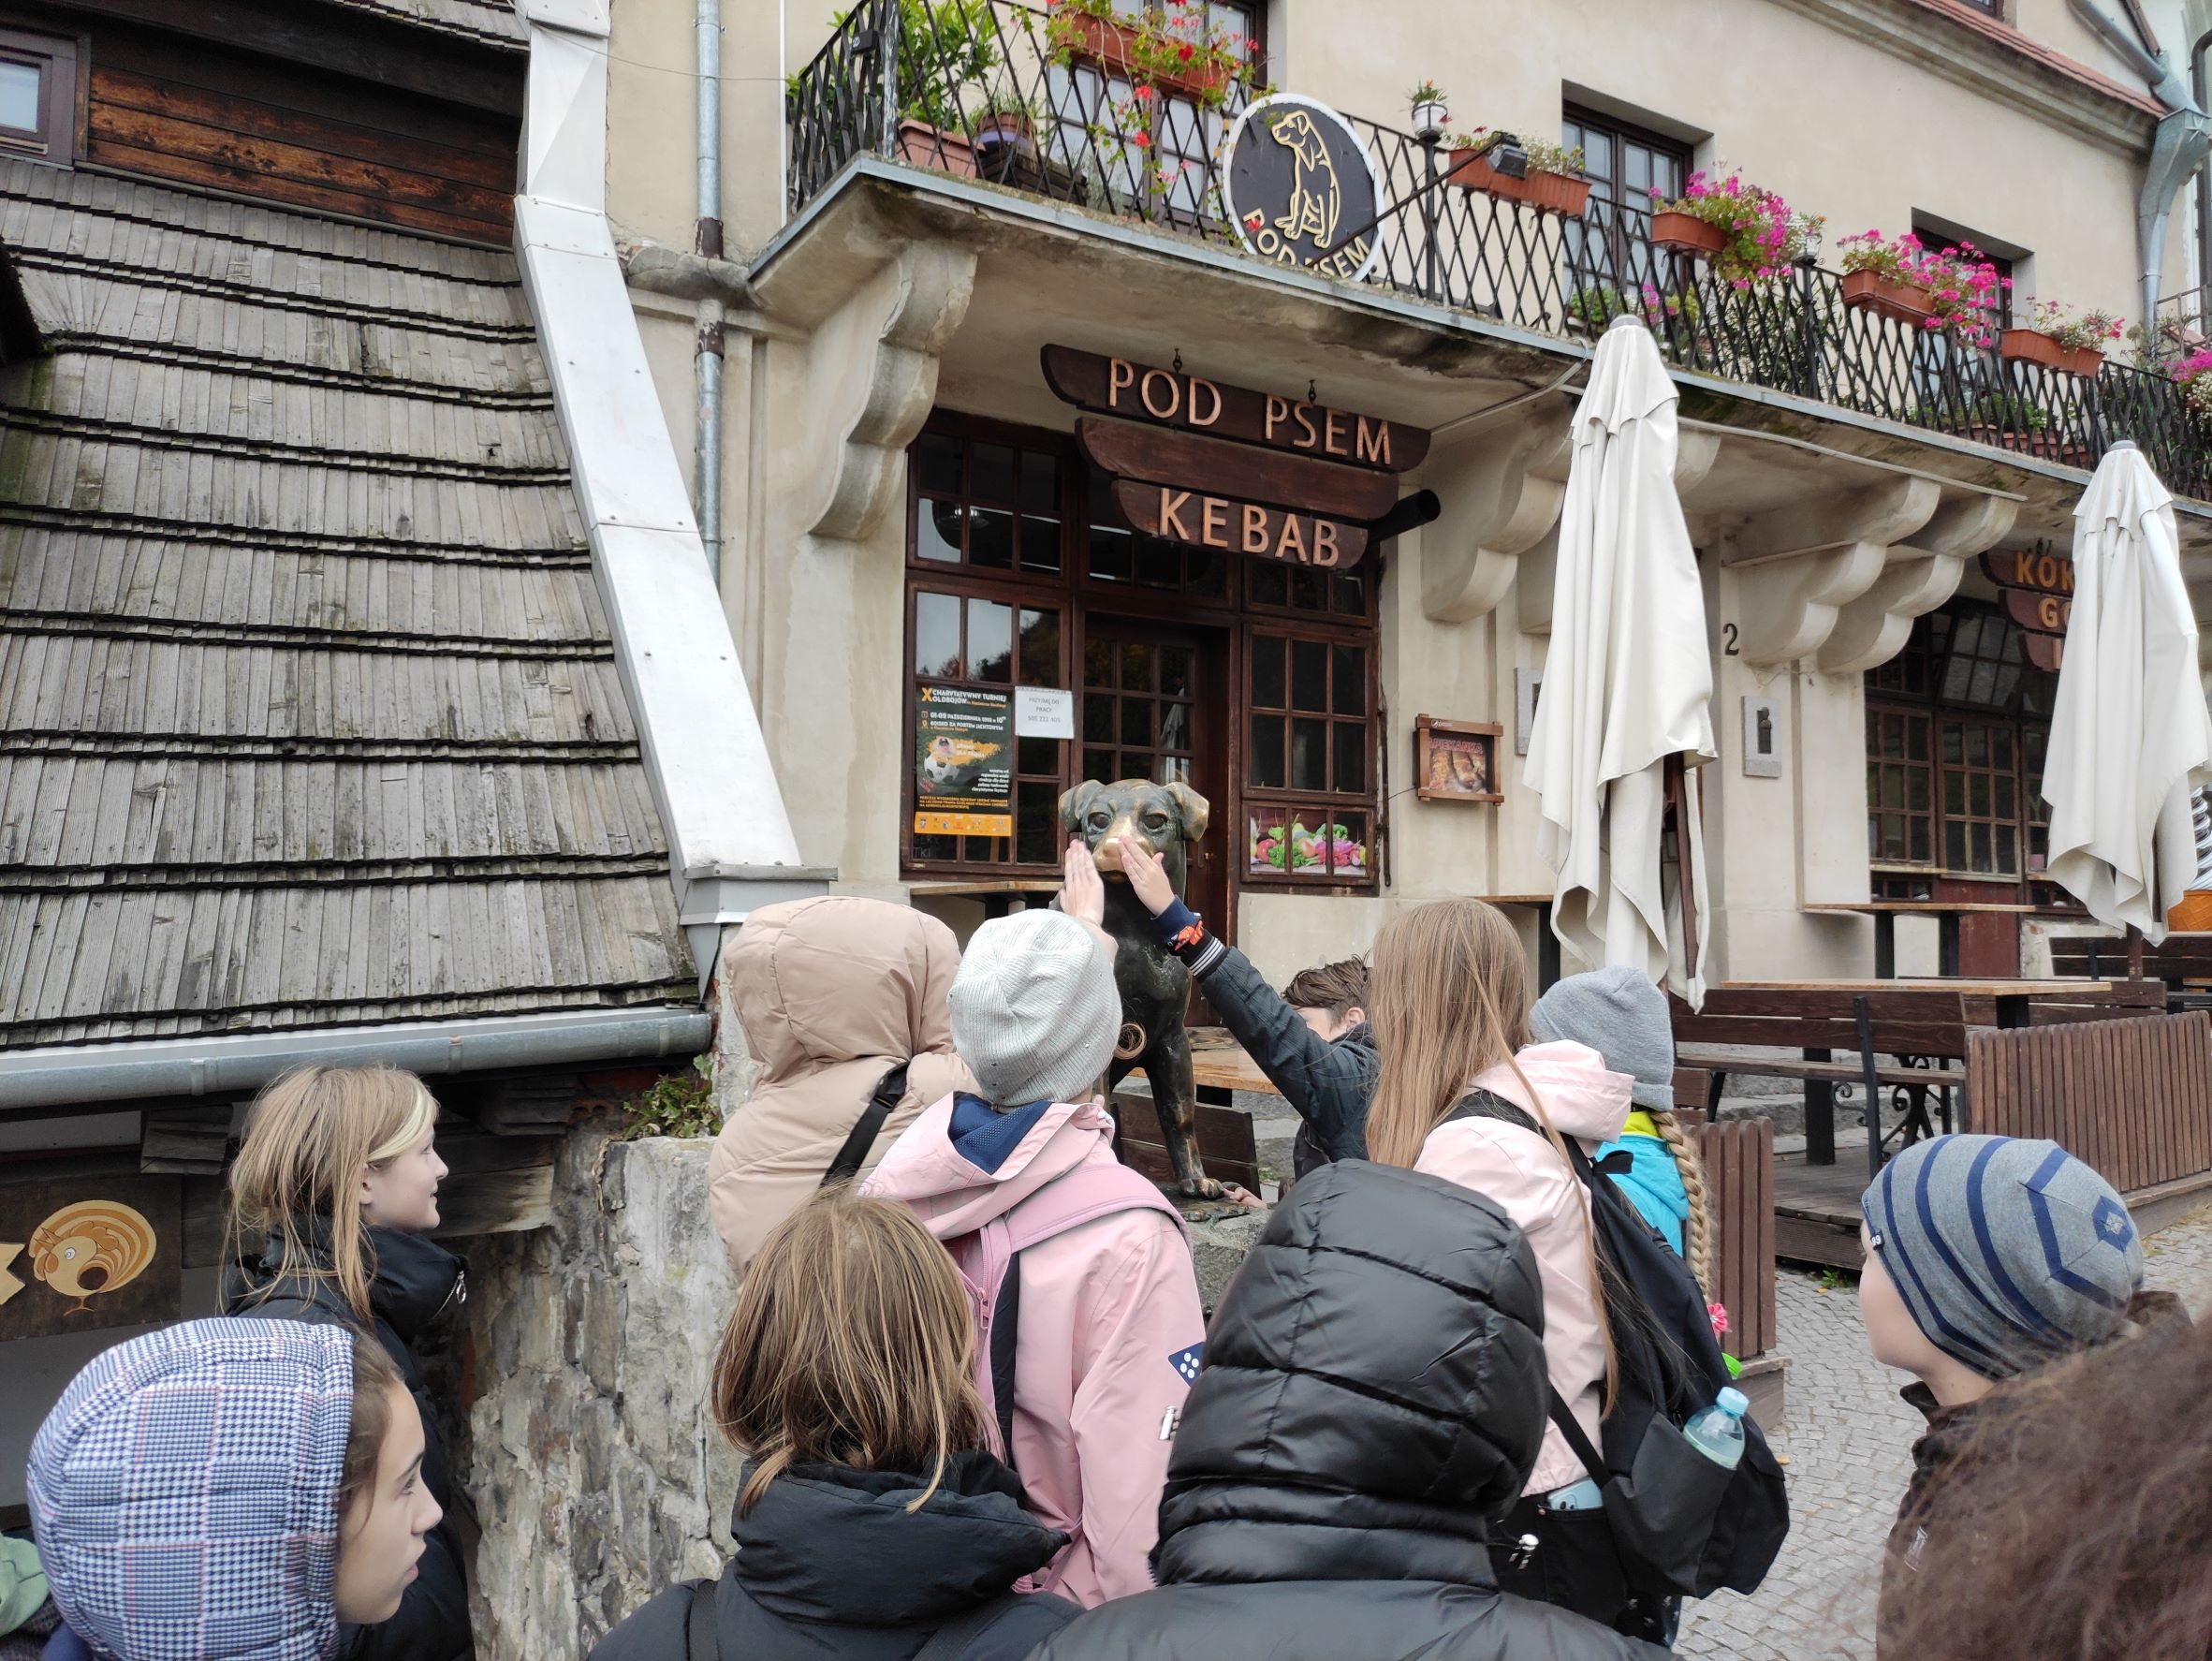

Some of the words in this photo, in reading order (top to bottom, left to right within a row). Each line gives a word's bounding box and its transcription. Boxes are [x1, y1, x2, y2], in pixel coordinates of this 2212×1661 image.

[1107, 357, 1223, 427] POD
[1265, 394, 1392, 466] PSEM
[1159, 487, 1340, 567] KEBAB
[1722, 623, 1739, 655] 2
